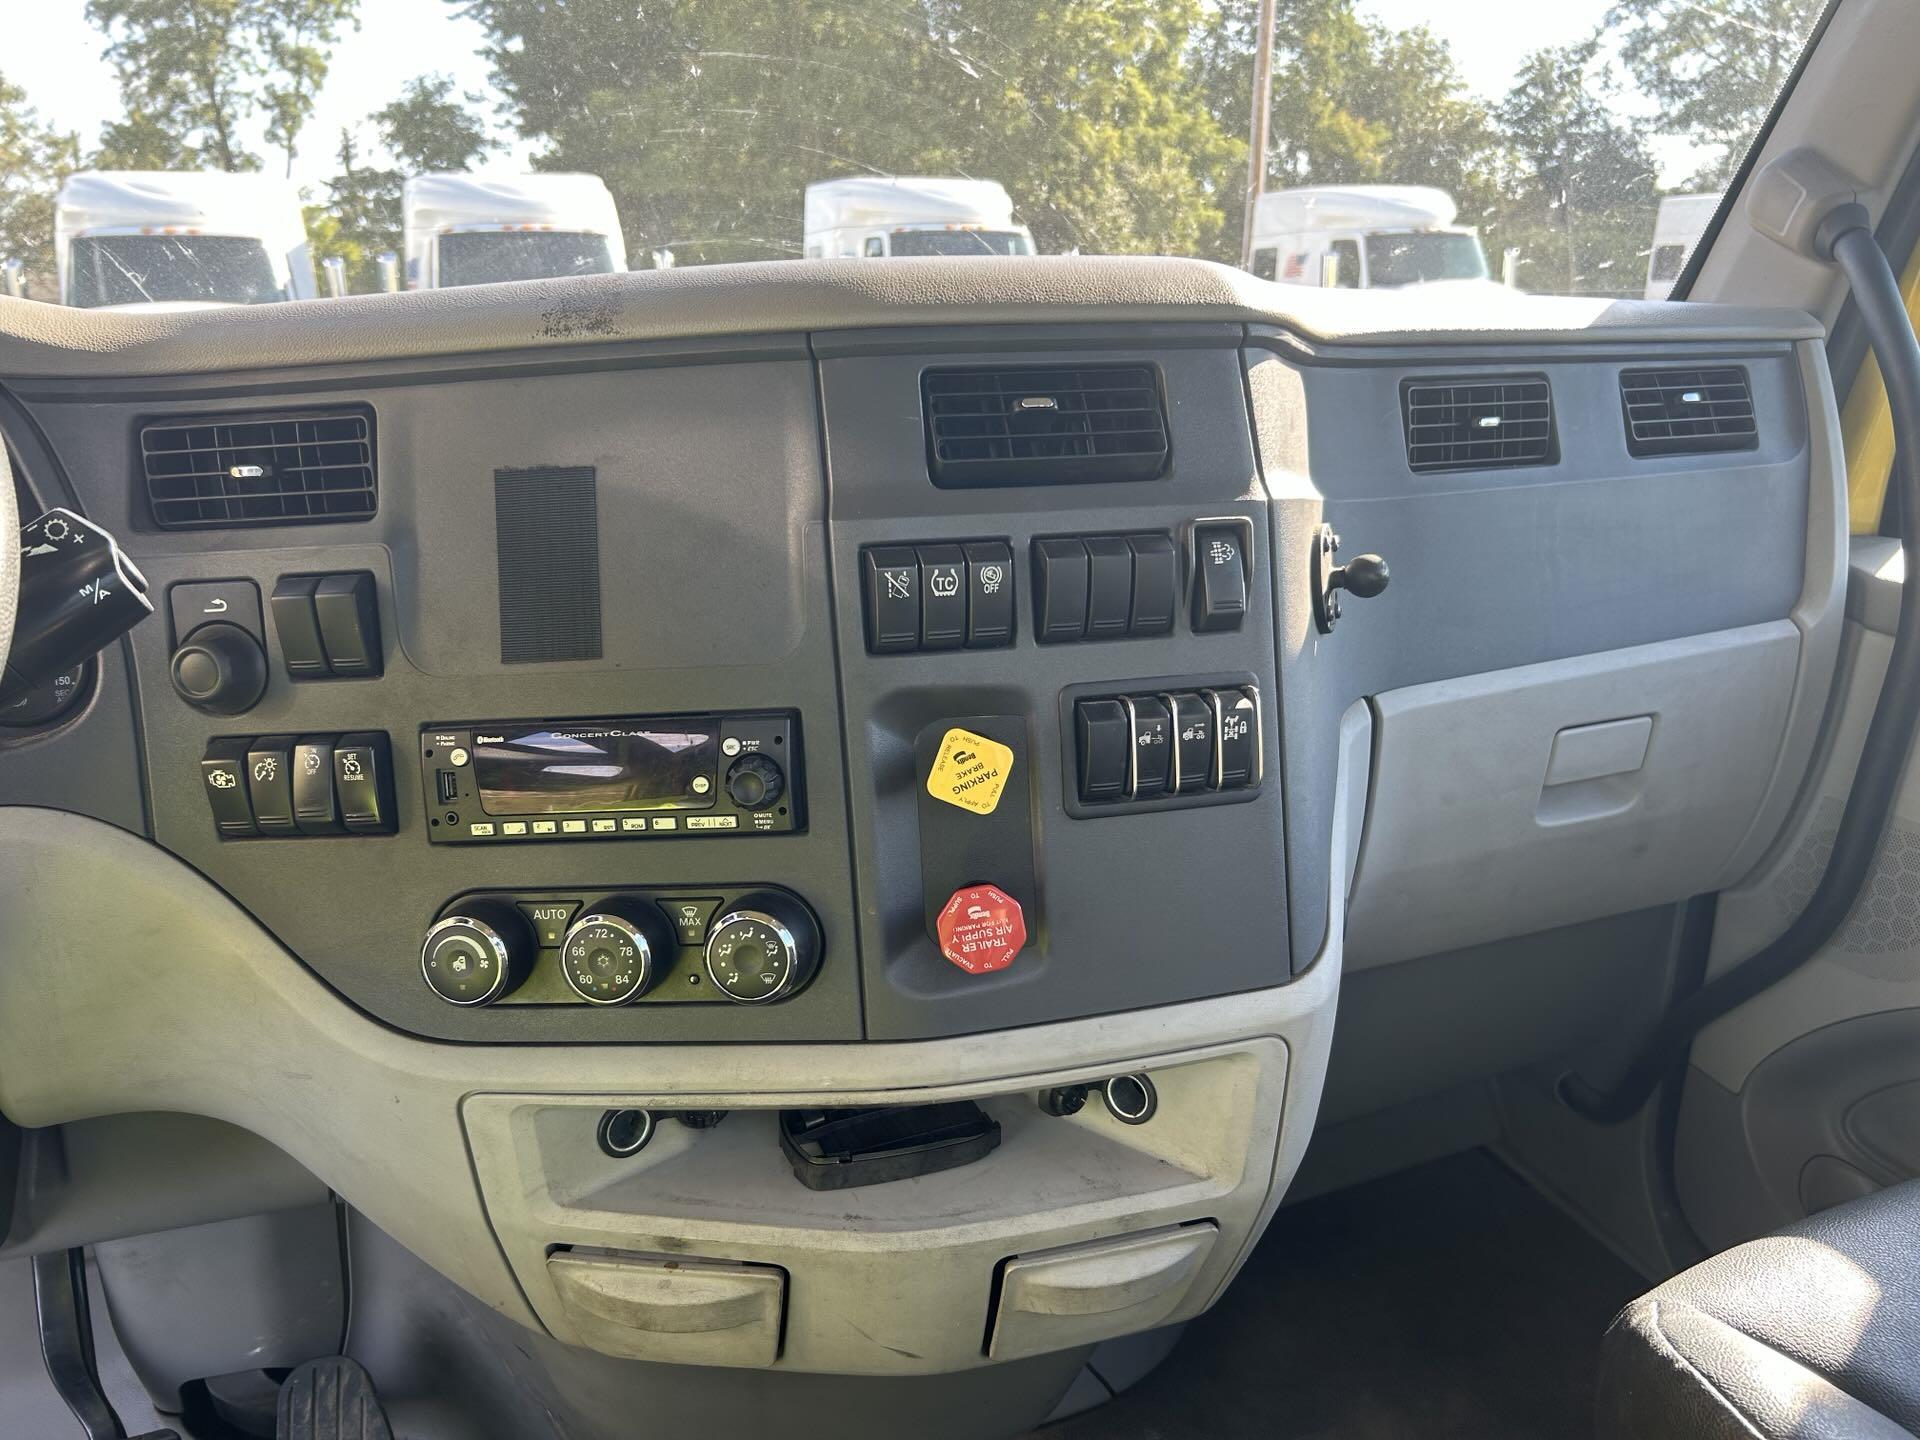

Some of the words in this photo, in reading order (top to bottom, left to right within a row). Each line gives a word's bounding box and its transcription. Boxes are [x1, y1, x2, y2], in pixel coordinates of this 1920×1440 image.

[936, 577, 954, 590] TC
[984, 584, 999, 594] OFF
[956, 762, 984, 780] BRAKE
[952, 768, 999, 794] PARKING
[534, 909, 566, 919] AUTO
[679, 918, 701, 926] MAX
[595, 929, 607, 938] 72
[995, 924, 1013, 935] AIR
[962, 937, 1007, 952] TRAILER
[572, 947, 585, 956] 66
[620, 947, 633, 956] 78
[580, 975, 593, 984] 60
[615, 975, 629, 984] 84
